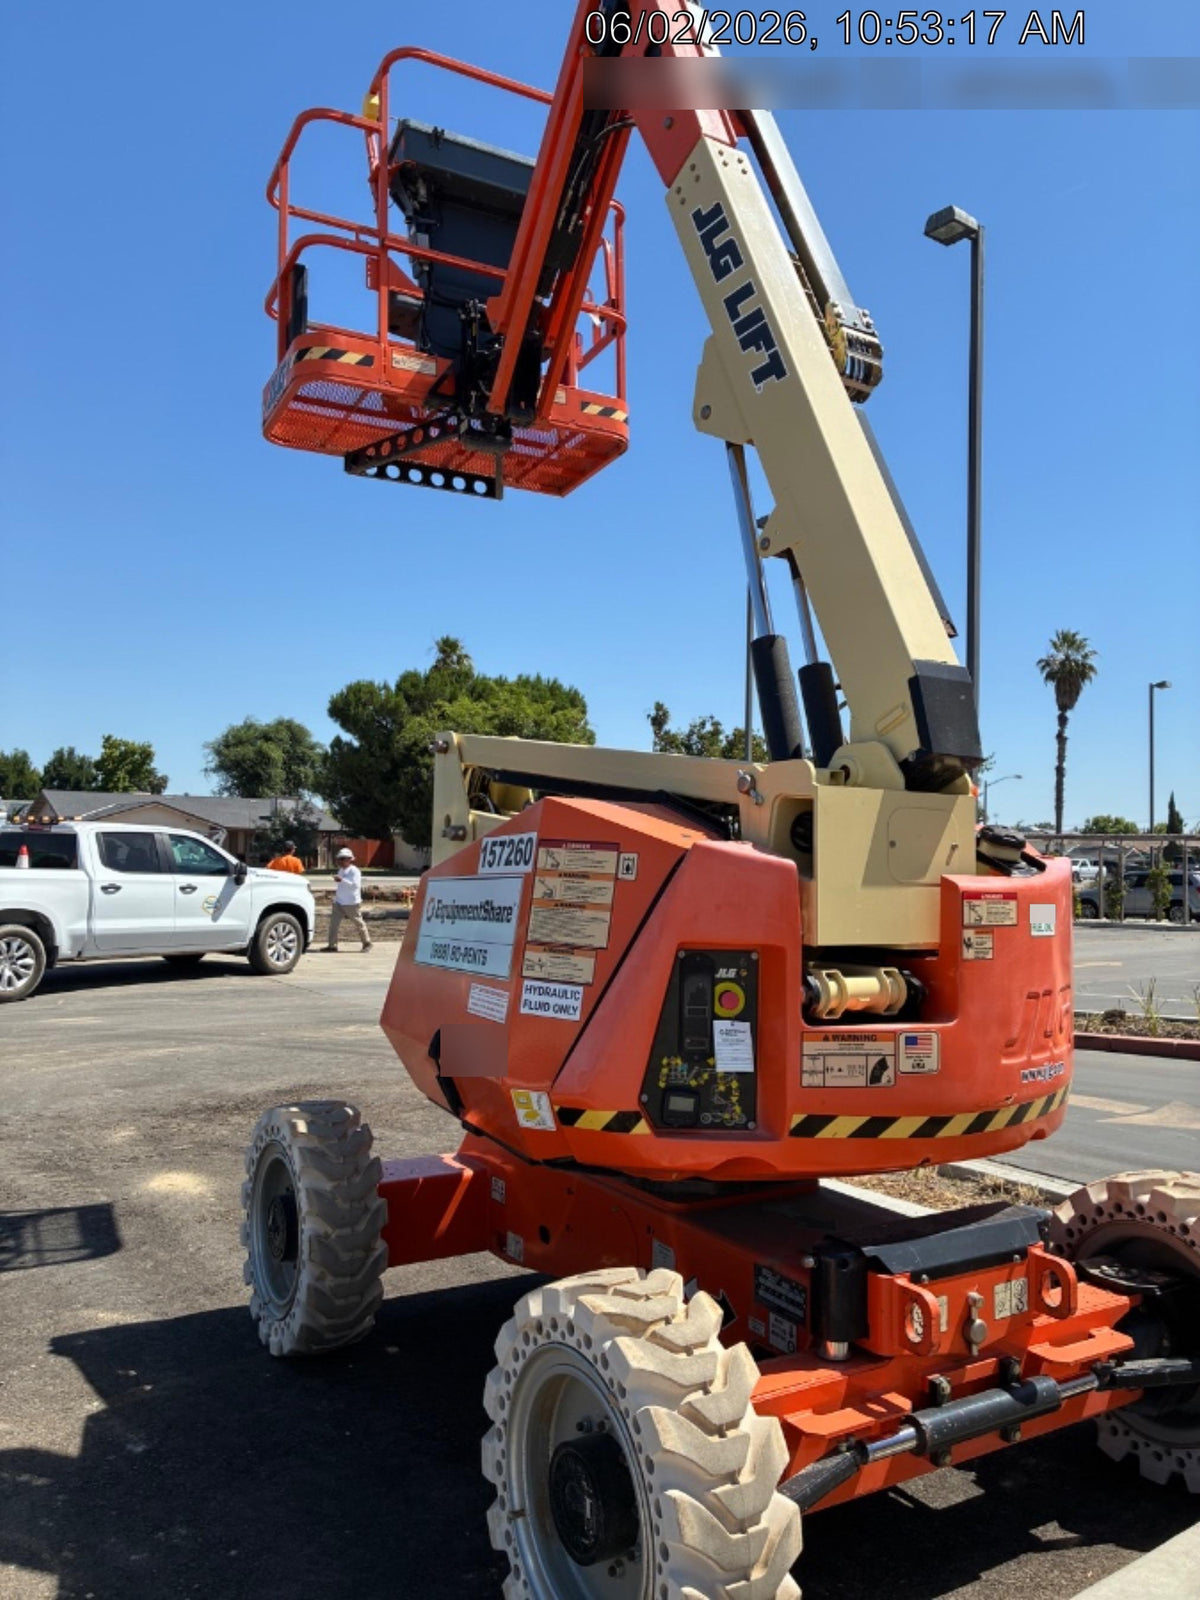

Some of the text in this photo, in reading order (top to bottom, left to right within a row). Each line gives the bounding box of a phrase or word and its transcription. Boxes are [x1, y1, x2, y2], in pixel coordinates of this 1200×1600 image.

[691, 202, 789, 387] JLG LIFT
[481, 837, 534, 868] 157260
[434, 899, 513, 925] EquipmentShare
[715, 968, 737, 979] JLG
[524, 984, 580, 1001] HYDRAULIC
[522, 998, 579, 1016] FLUID ONLY
[832, 1034, 877, 1042] WARNING
